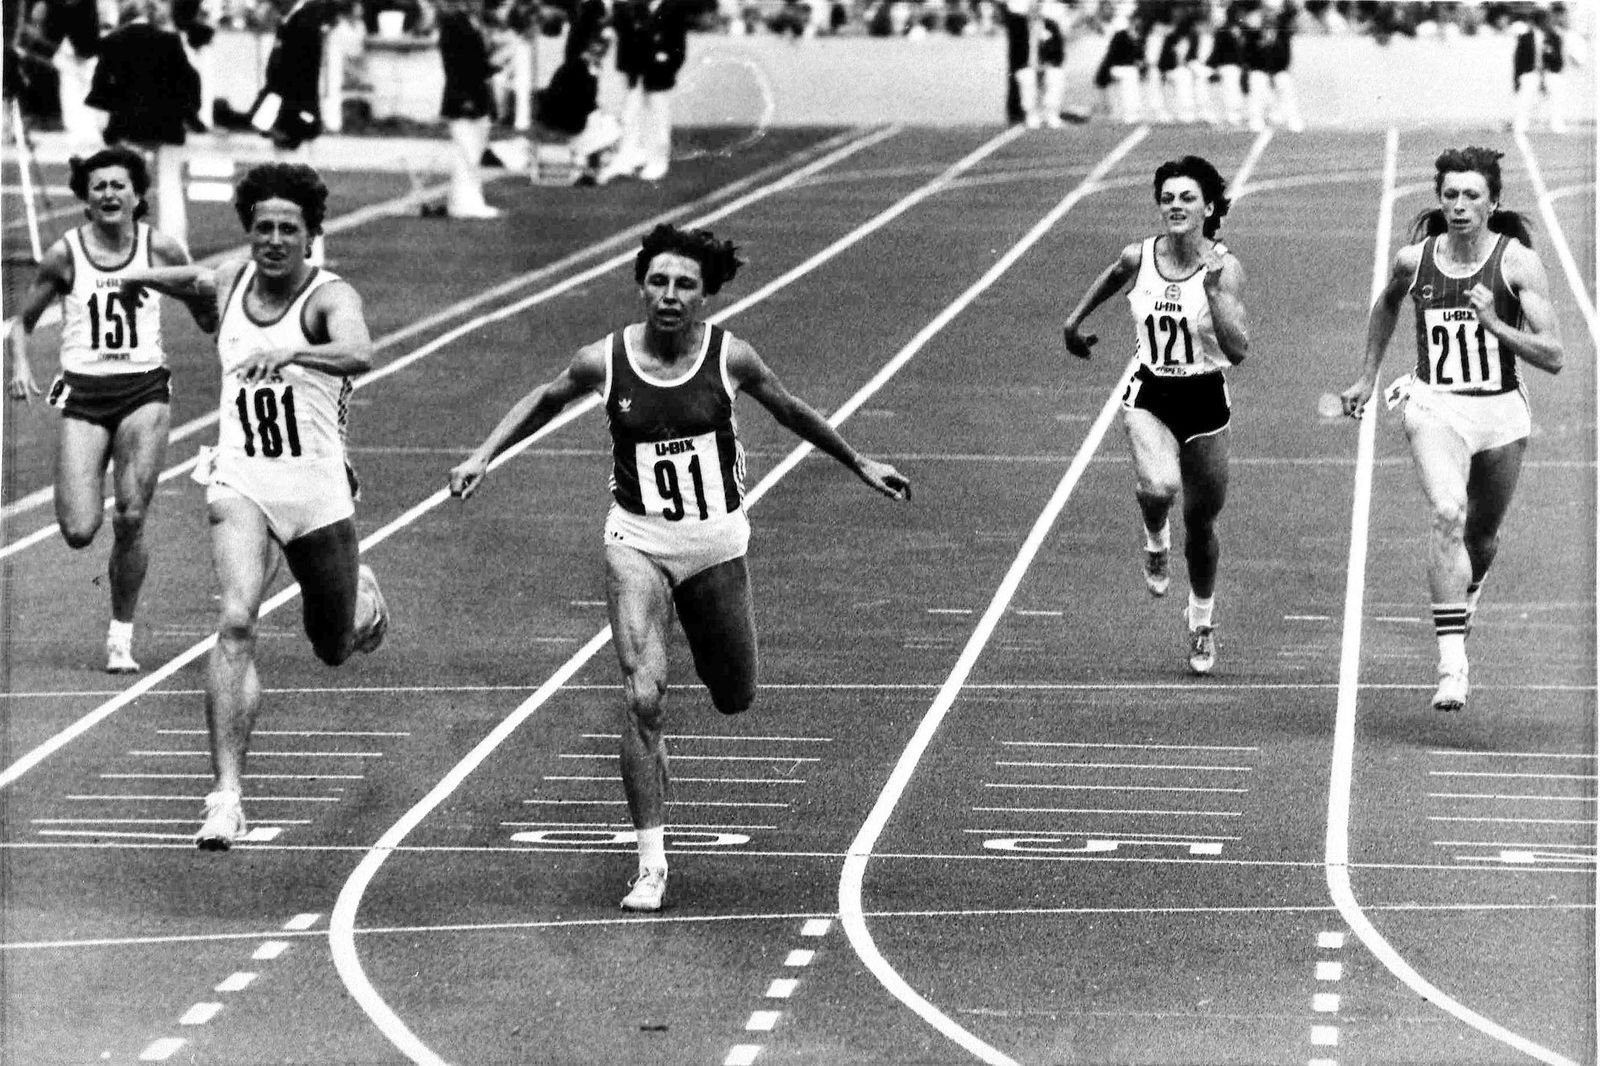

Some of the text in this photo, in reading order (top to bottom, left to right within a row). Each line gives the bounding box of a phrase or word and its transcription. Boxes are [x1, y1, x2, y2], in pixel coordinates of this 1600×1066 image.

[87, 292, 138, 350] 151
[1144, 313, 1194, 365] 121
[1443, 310, 1475, 322] U-BIX
[1432, 323, 1490, 385] 211
[235, 385, 302, 458] 181
[654, 438, 696, 456] U-BIX
[653, 454, 709, 522] 91
[982, 838, 1224, 855] 5
